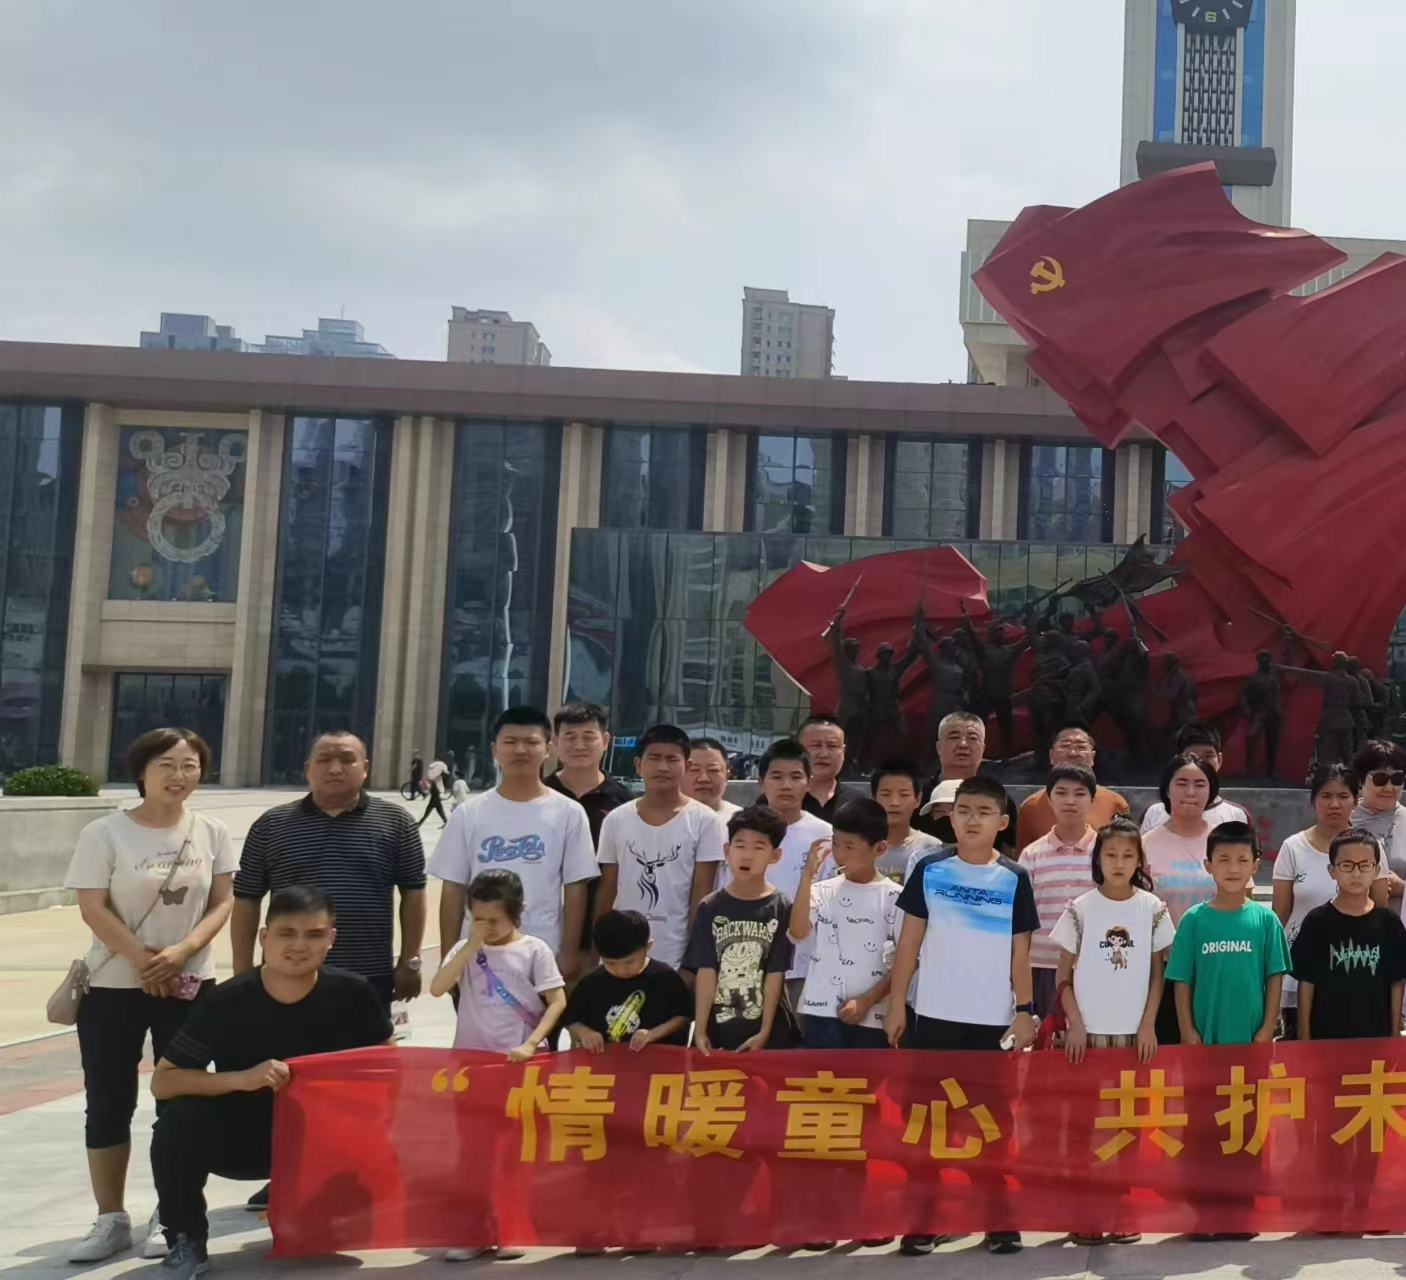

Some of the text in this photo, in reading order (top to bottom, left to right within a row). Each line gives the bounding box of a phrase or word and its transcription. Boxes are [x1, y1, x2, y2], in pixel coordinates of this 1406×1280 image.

[1205, 11, 1217, 22] 6
[934, 888, 1003, 906] RUNNING
[949, 883, 989, 897] ANTA
[1202, 940, 1253, 955] ORIGINAL
